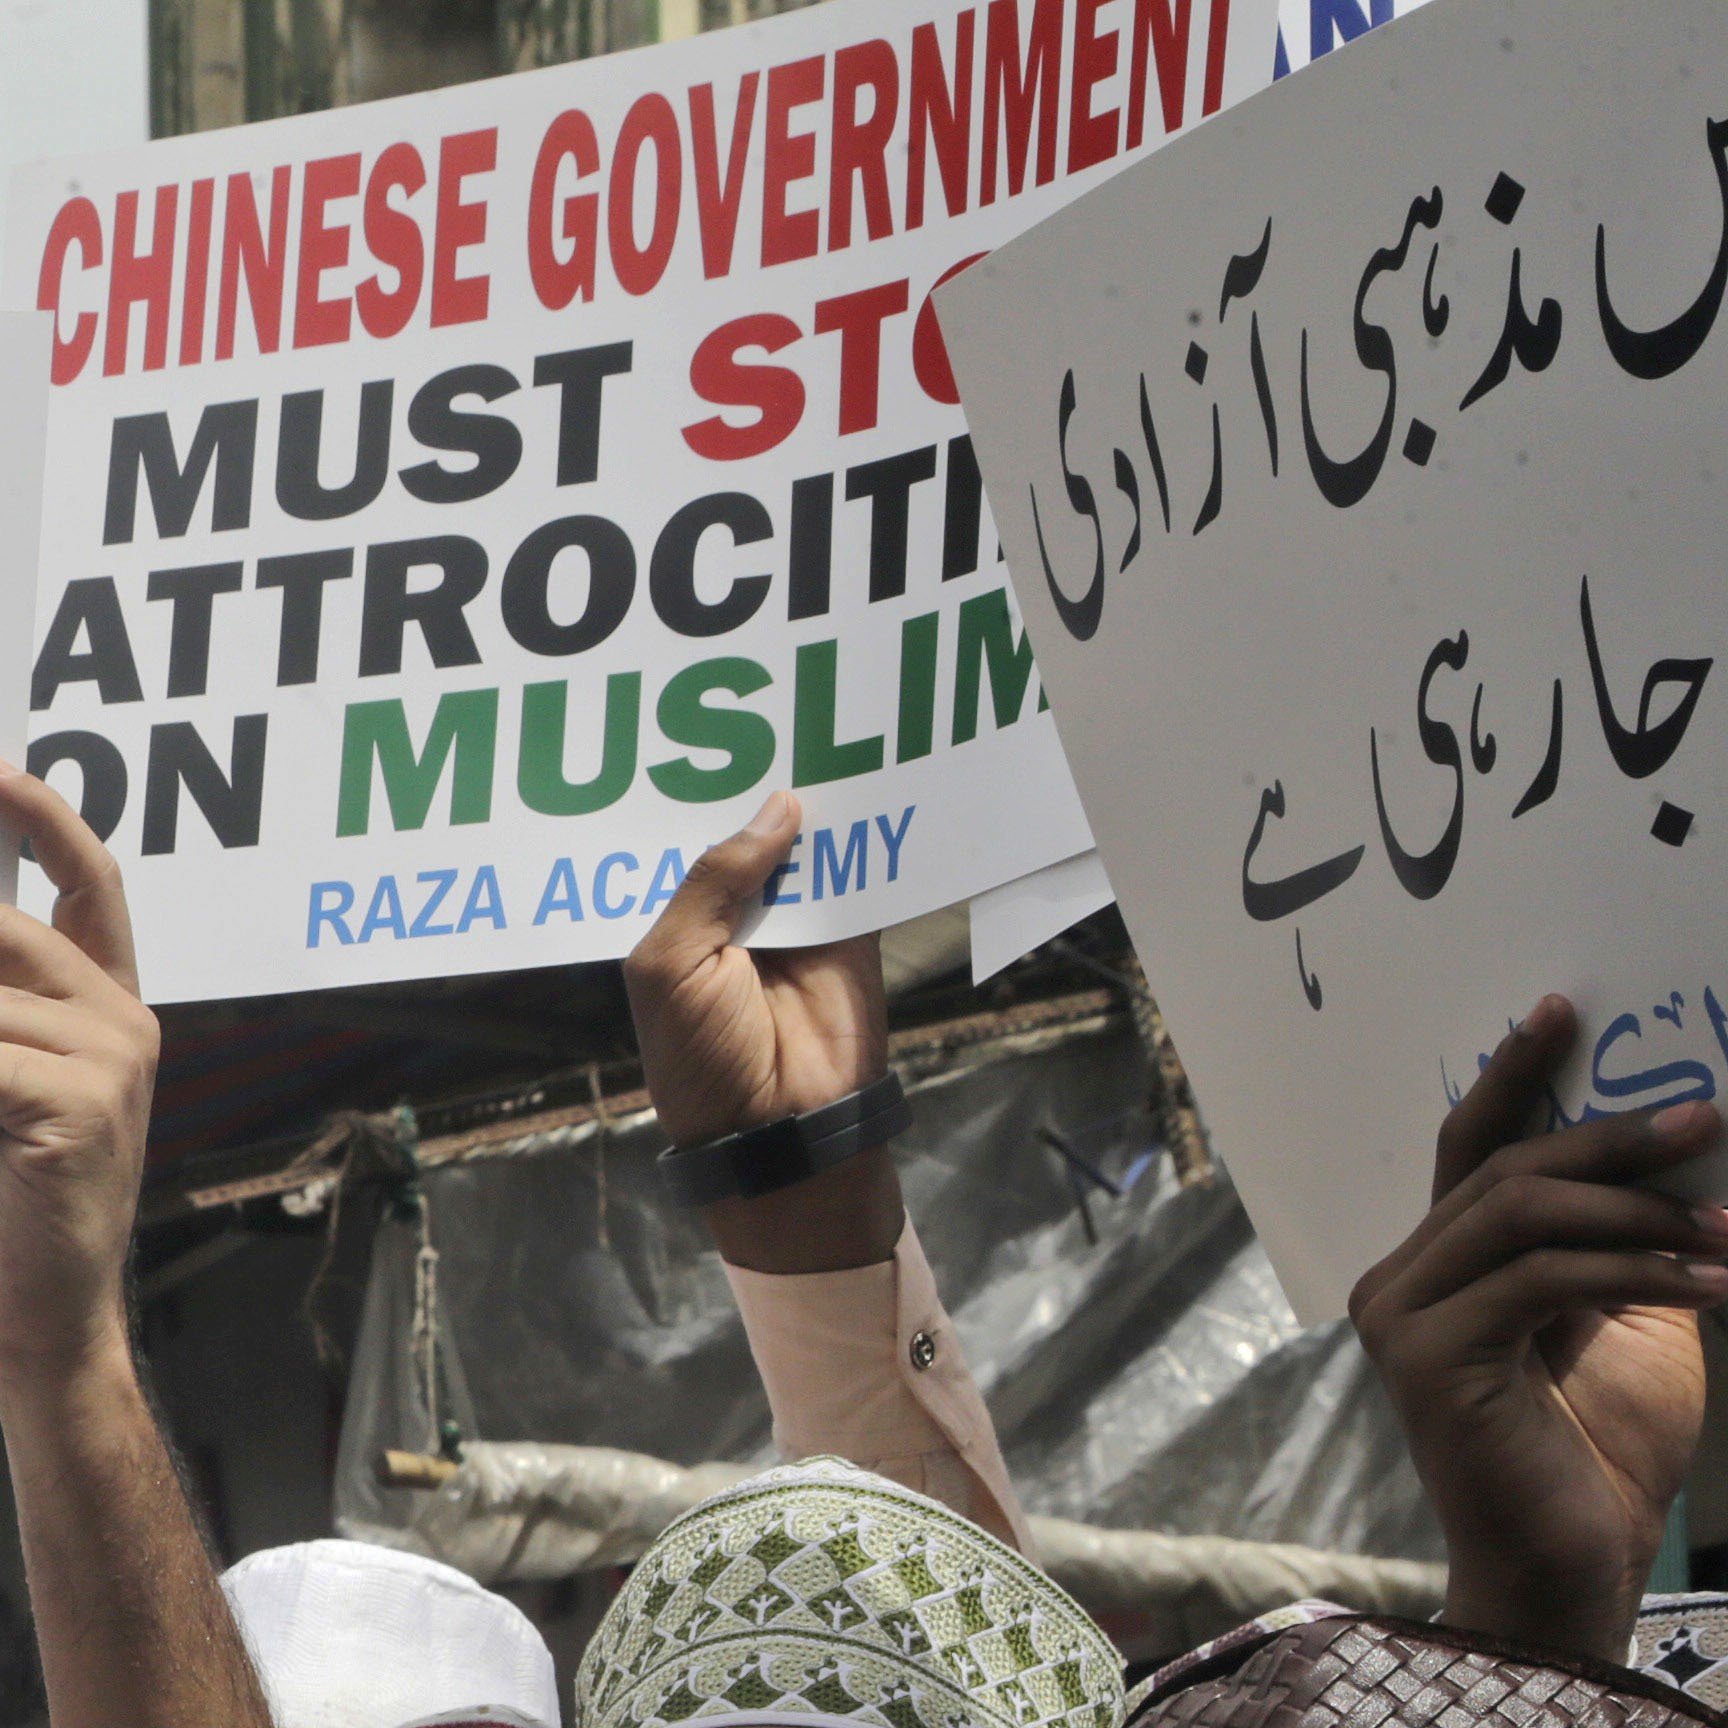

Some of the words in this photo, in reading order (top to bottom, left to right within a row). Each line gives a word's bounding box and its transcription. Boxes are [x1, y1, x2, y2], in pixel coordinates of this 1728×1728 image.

[38, 127, 500, 386] CHINESE
[1300, 171, 1562, 508] مذہبی
[103, 340, 634, 547] MUST
[1029, 215, 1279, 642] آزادی
[29, 434, 1008, 712] ATTROCITI
[17, 713, 269, 863] ON
[336, 586, 1049, 838] MUSLIM
[306, 864, 508, 949] RAZA
[533, 805, 917, 927] ACAEMY
[1242, 779, 1365, 1011] ہے
